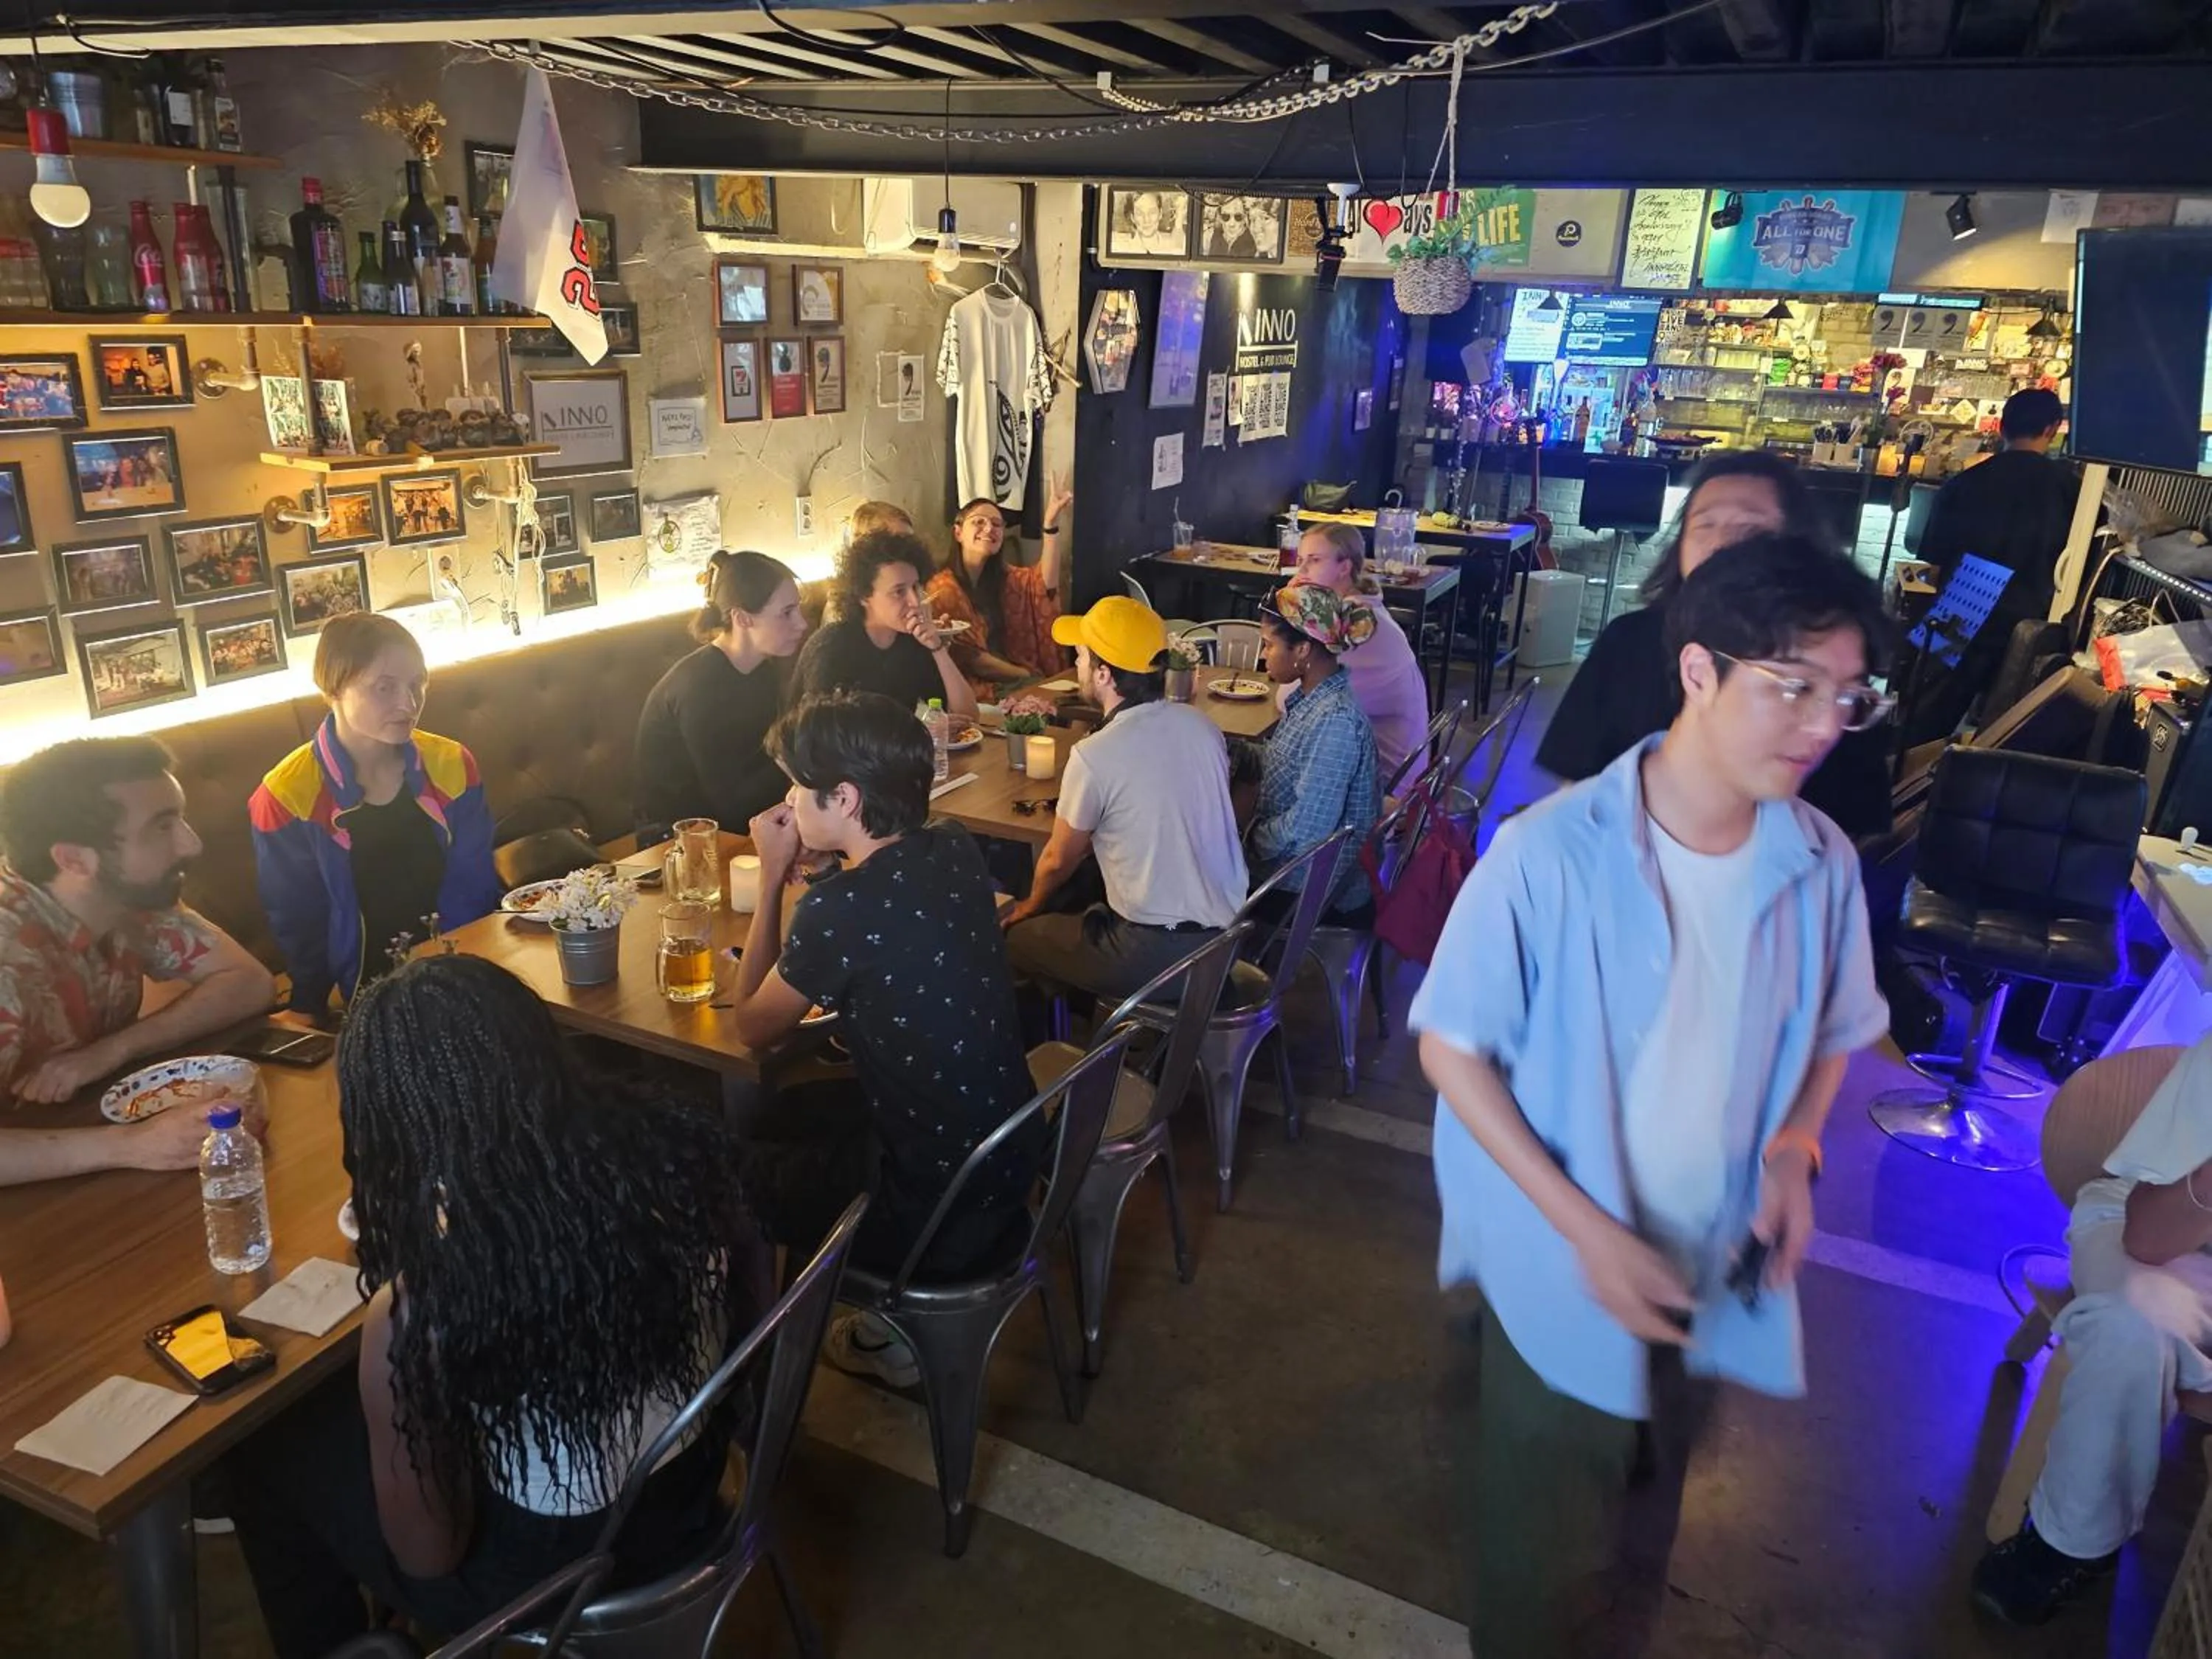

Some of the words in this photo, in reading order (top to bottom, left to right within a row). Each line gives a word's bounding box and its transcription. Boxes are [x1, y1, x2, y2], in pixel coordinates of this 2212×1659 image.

[1478, 203, 1522, 247] LIFE
[1762, 225, 1792, 240] ALL
[1813, 225, 1847, 242] ONE
